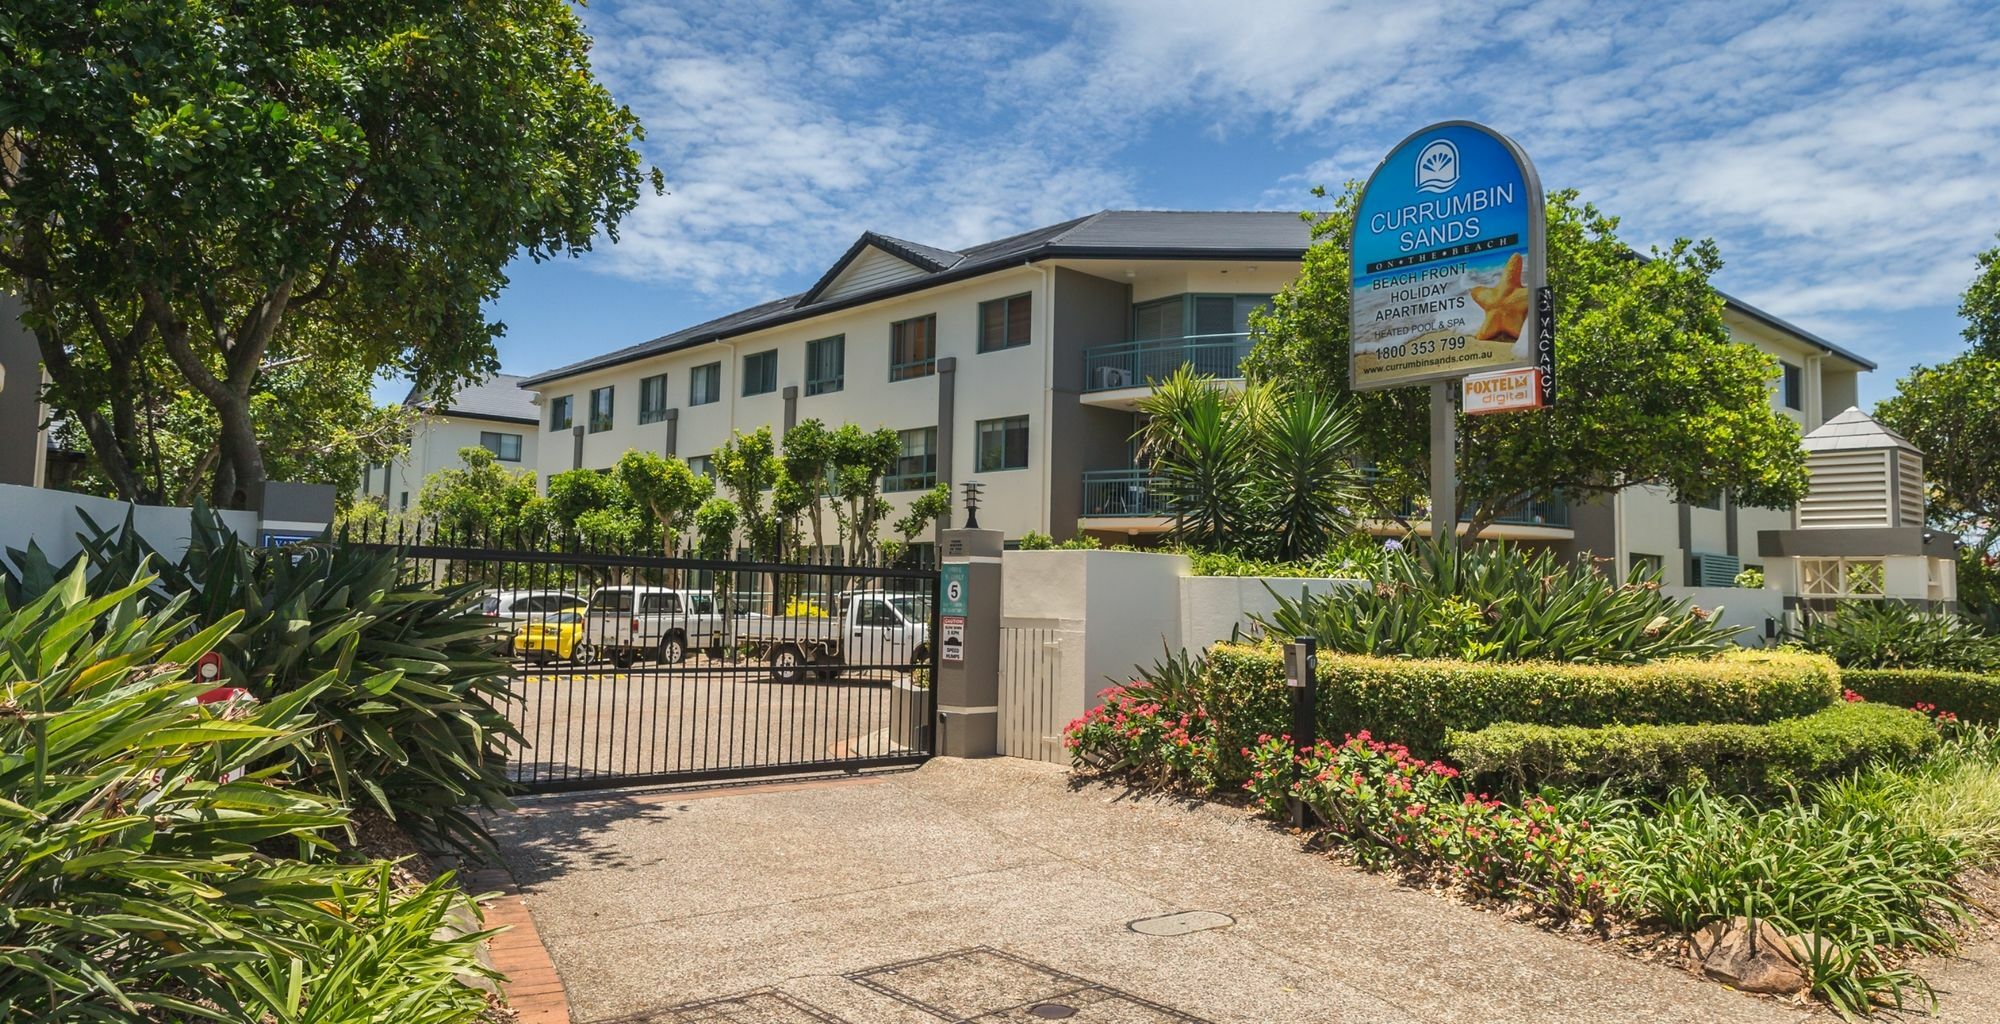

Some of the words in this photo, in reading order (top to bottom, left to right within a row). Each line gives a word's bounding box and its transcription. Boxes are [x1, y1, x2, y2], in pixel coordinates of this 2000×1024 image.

[1371, 183, 1513, 233] CURRUMBIN
[1400, 217, 1480, 252] SANDS
[1373, 272, 1417, 290] BEACH
[1422, 263, 1467, 281] FRONT
[1391, 283, 1448, 303] HOLIDAY
[1375, 297, 1465, 321] APARTMENTS
[1374, 327, 1409, 340] HEATED
[1412, 321, 1435, 333] POOL
[1438, 321, 1445, 330] &
[1447, 317, 1465, 328] SPA
[1375, 345, 1406, 360] 1800
[1411, 341, 1435, 355] 353
[1440, 336, 1465, 351] 799
[1539, 317, 1552, 398] VACANCY
[1363, 351, 1493, 374] www.currumbinsands.com.au
[1466, 378, 1514, 395] FOXTEL
[1482, 390, 1528, 405] digital
[951, 585, 958, 599] 5
